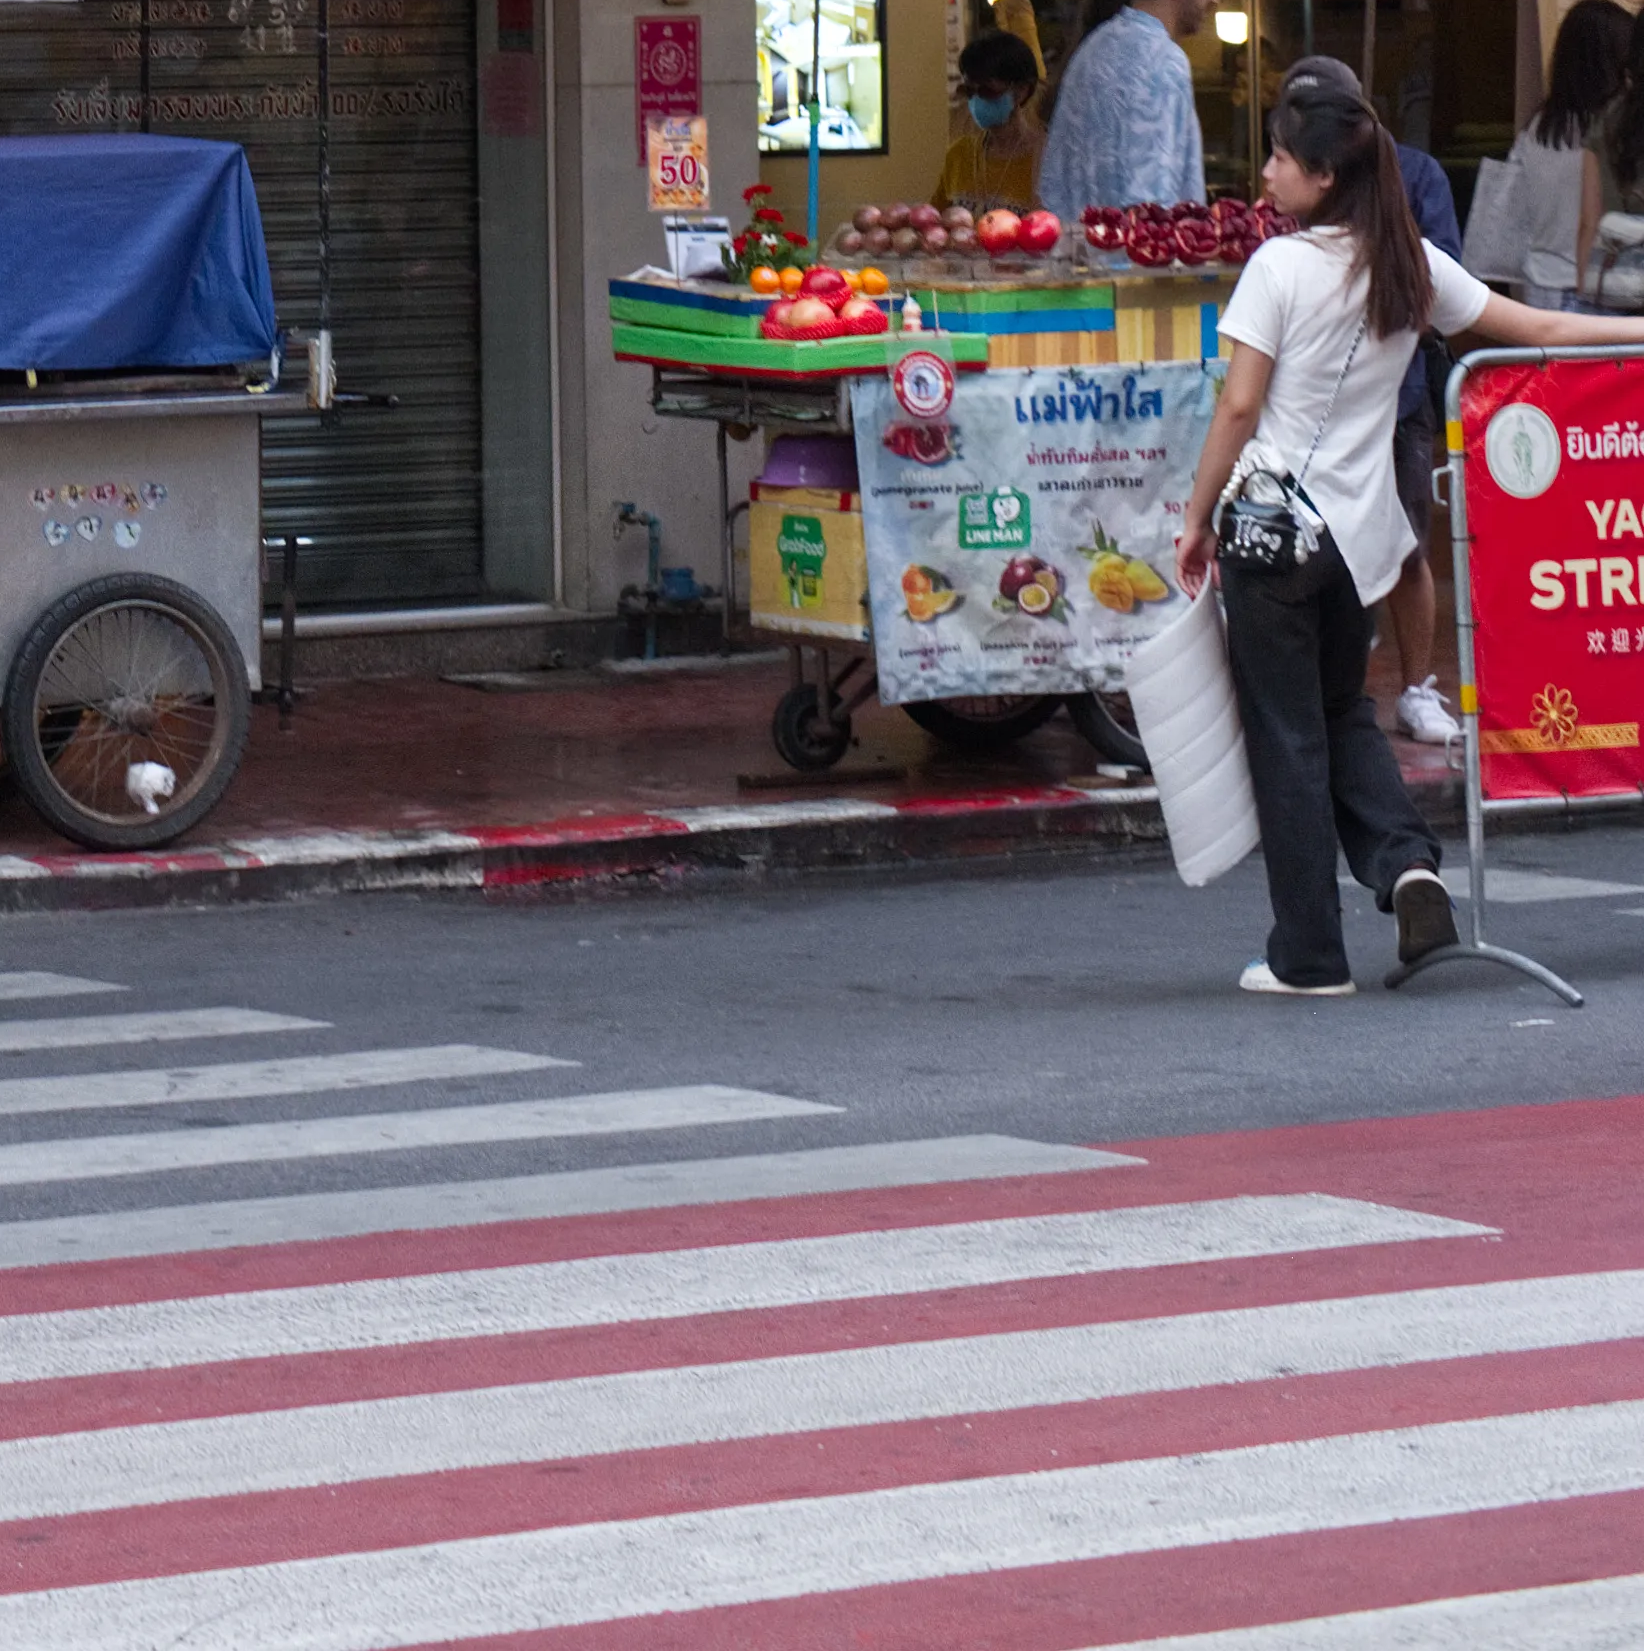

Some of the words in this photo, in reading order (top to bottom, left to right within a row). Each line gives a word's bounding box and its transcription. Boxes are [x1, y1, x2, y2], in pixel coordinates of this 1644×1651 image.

[660, 155, 698, 186] 50
[1014, 373, 1165, 425] แม่ฟ้าใส
[966, 527, 992, 544] LINE
[993, 527, 1024, 544] MAN
[1584, 498, 1644, 541] YA
